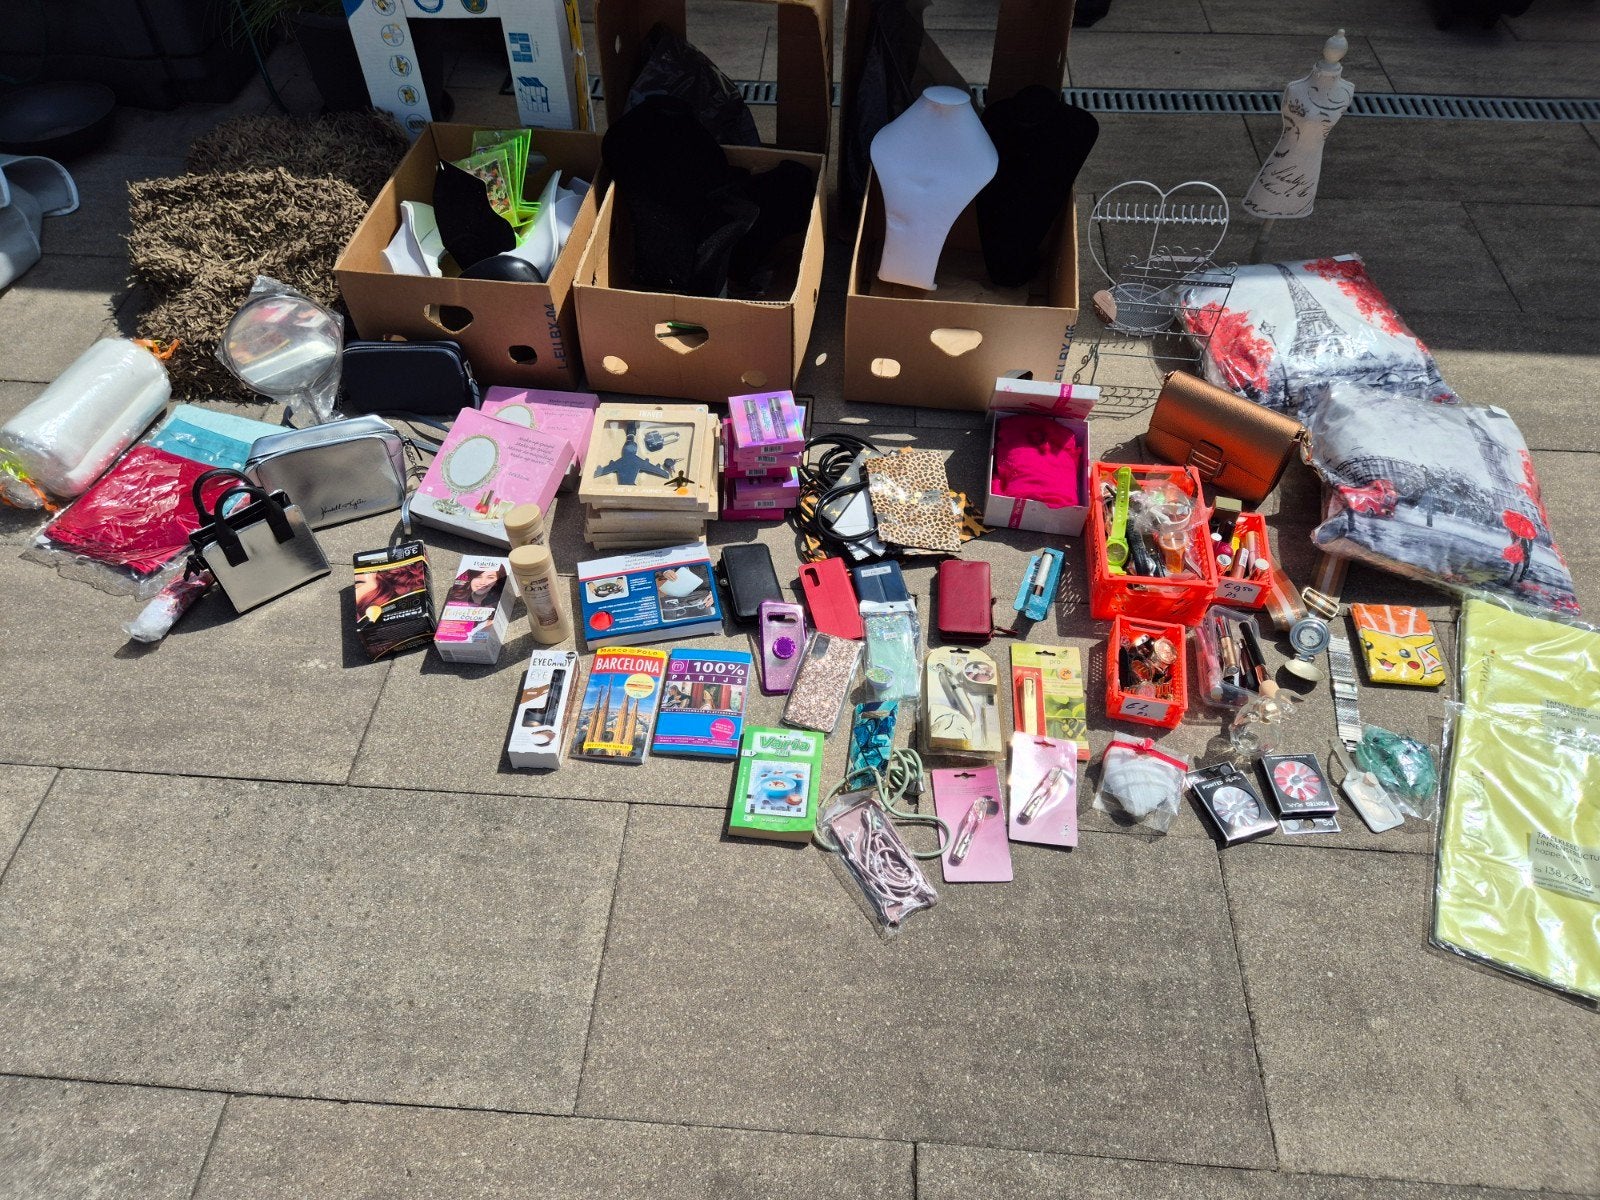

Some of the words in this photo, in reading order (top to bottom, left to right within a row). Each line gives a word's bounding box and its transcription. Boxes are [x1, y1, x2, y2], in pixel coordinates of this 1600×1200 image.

[595, 657, 660, 673] BARCELONA
[693, 662, 745, 676] 100%
[671, 674, 743, 684] PARIJS
[1545, 866, 1561, 878] 138
[1572, 873, 1592, 887] 220
